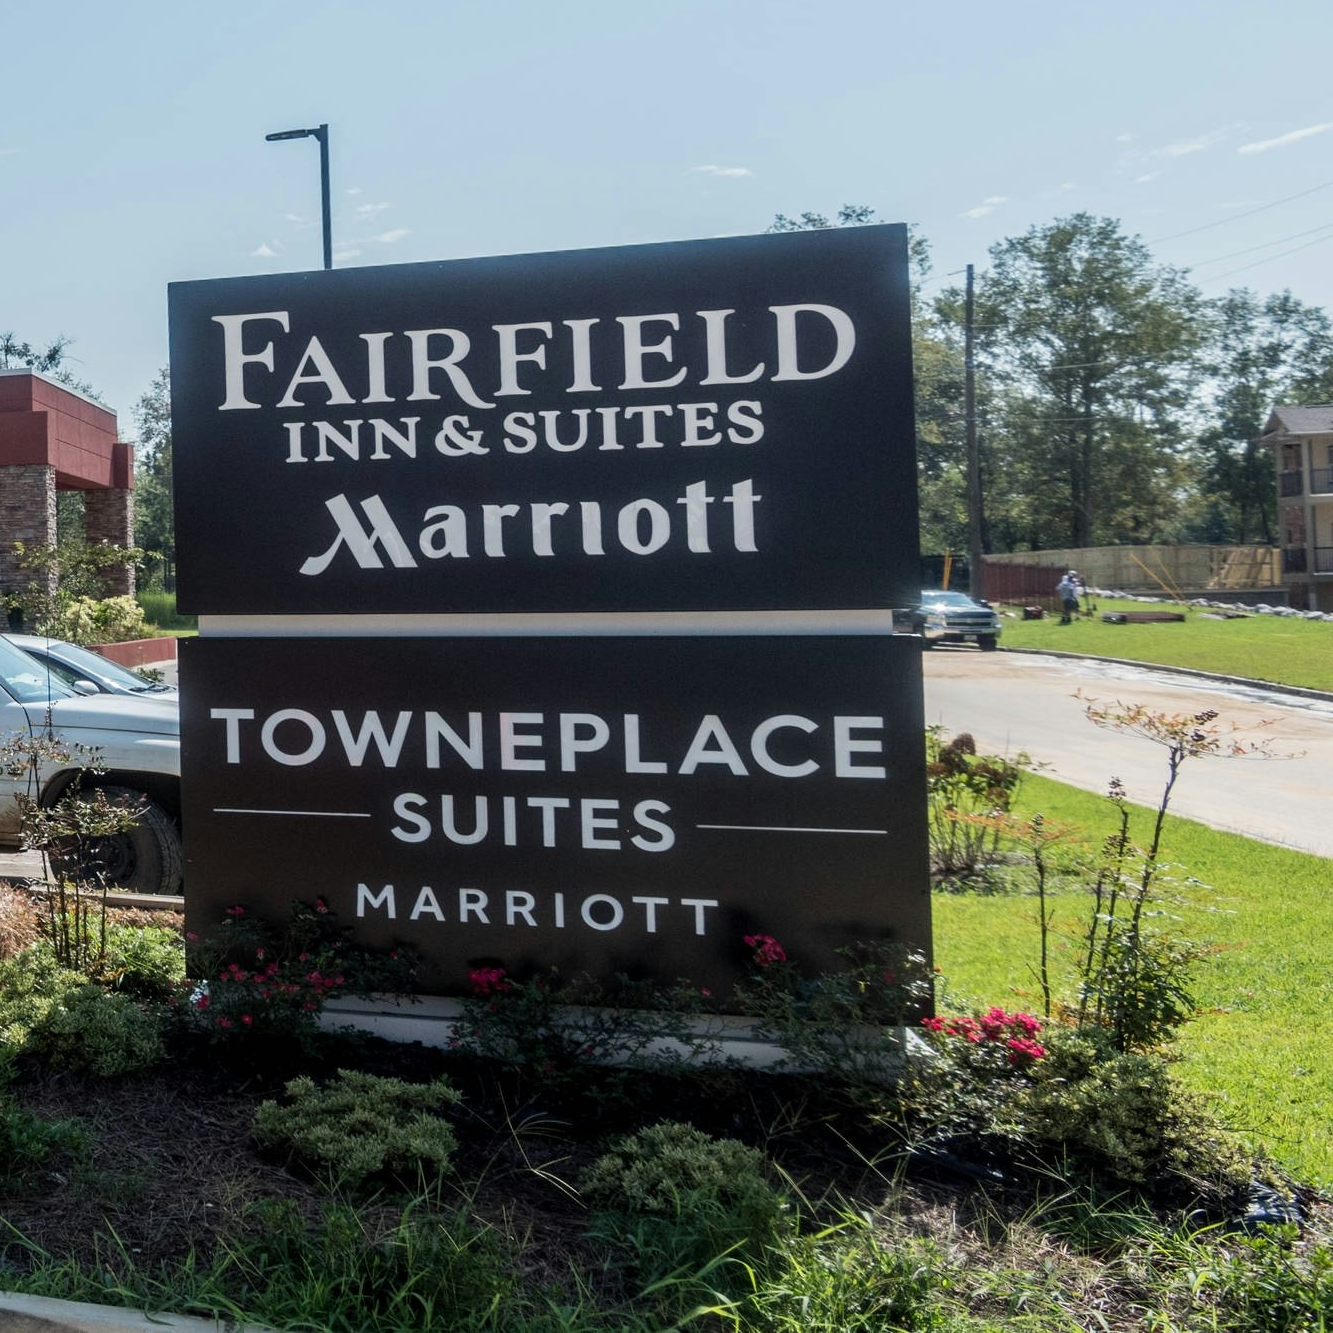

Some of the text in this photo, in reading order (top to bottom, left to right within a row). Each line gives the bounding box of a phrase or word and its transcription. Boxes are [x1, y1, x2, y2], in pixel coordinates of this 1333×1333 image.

[211, 303, 856, 411] FAIRFIELD
[283, 400, 765, 463] INN & SUITES
[299, 478, 762, 576] Marriott
[210, 708, 886, 779] TOWNEPLACE
[391, 792, 675, 852] SUITES
[356, 883, 719, 935] MARRIOTT
